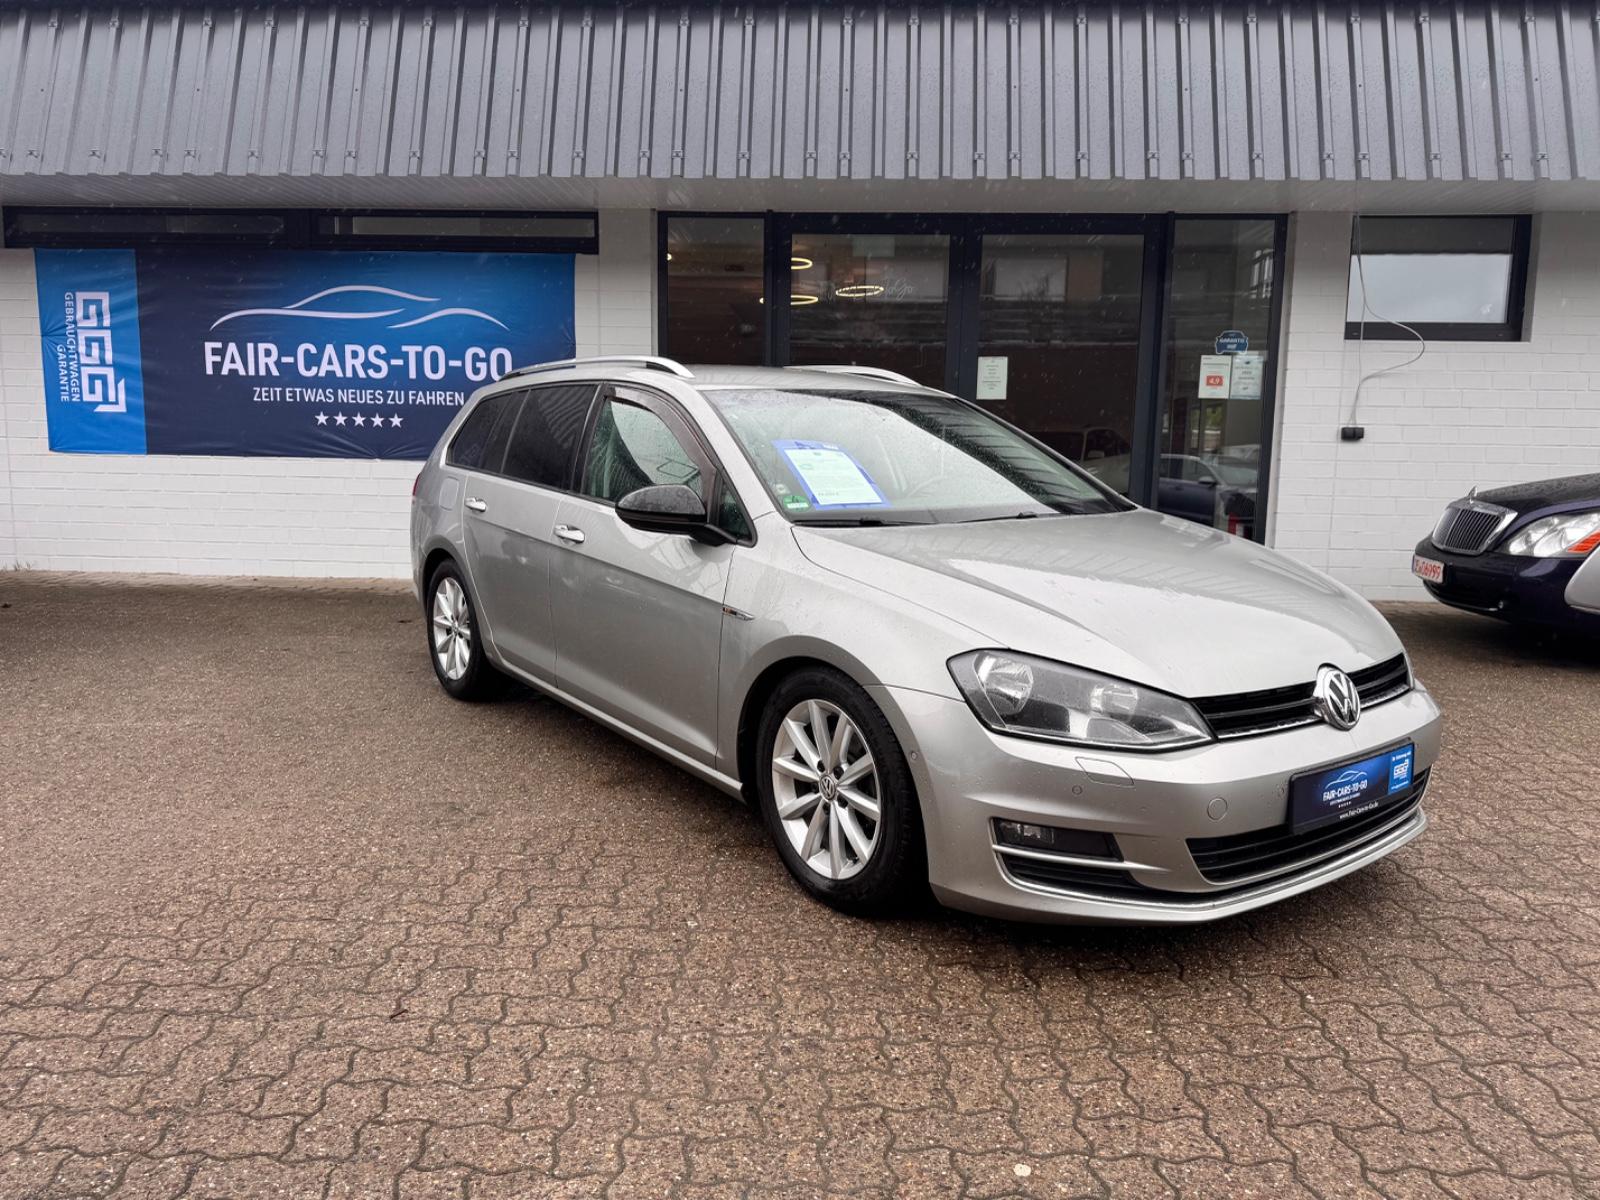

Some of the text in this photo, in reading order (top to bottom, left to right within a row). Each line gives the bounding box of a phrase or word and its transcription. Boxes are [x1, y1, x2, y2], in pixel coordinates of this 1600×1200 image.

[64, 291, 81, 403] GEBRAUCHTWAGEN
[204, 341, 513, 382] FAIR-CARS-TO-GO
[57, 344, 70, 403] GARANTIE
[253, 387, 465, 406] ZEIT ETWAS NEUES ZU FAHREN
[1323, 779, 1368, 801] FAIR-CARS-TO-GO
